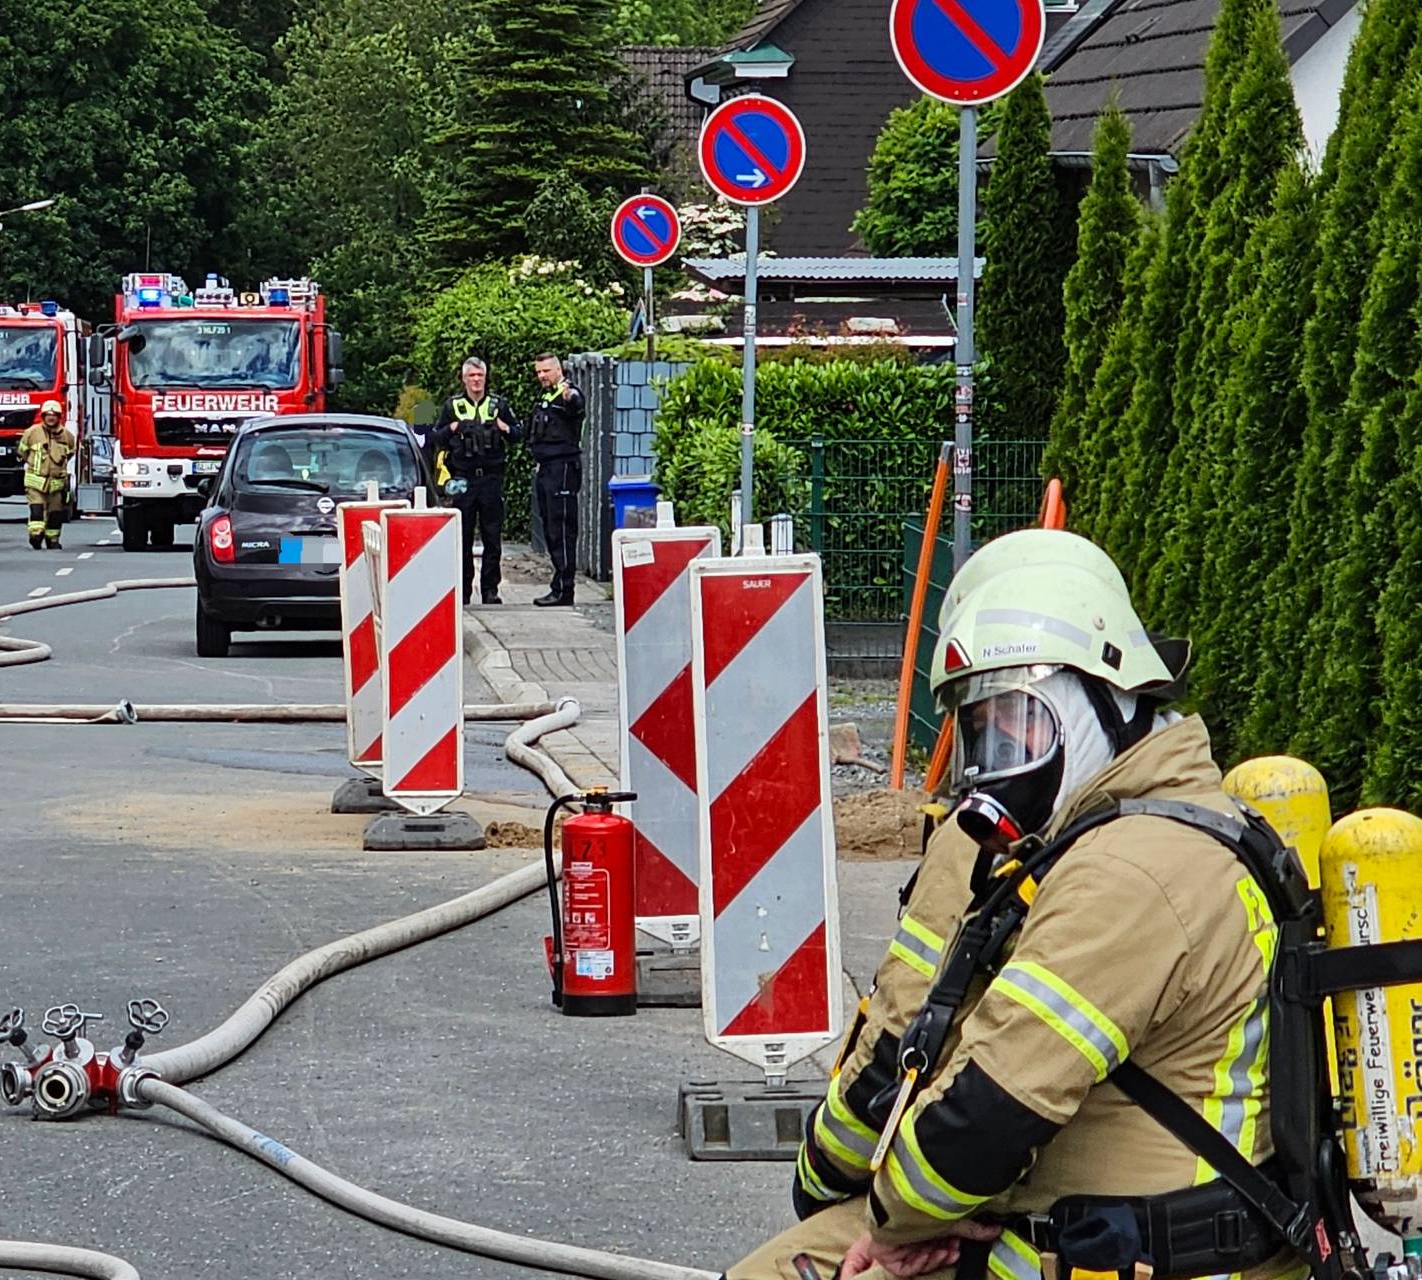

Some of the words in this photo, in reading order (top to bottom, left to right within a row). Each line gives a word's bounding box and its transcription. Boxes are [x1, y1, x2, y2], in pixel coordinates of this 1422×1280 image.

[152, 395, 278, 411] FEUERWEHR
[193, 423, 237, 433] MAN
[241, 541, 270, 549] MICRA
[742, 579, 772, 589] SAUER
[1365, 990, 1384, 1069] Feuerwe
[1371, 1077, 1393, 1173] Freiwillige
